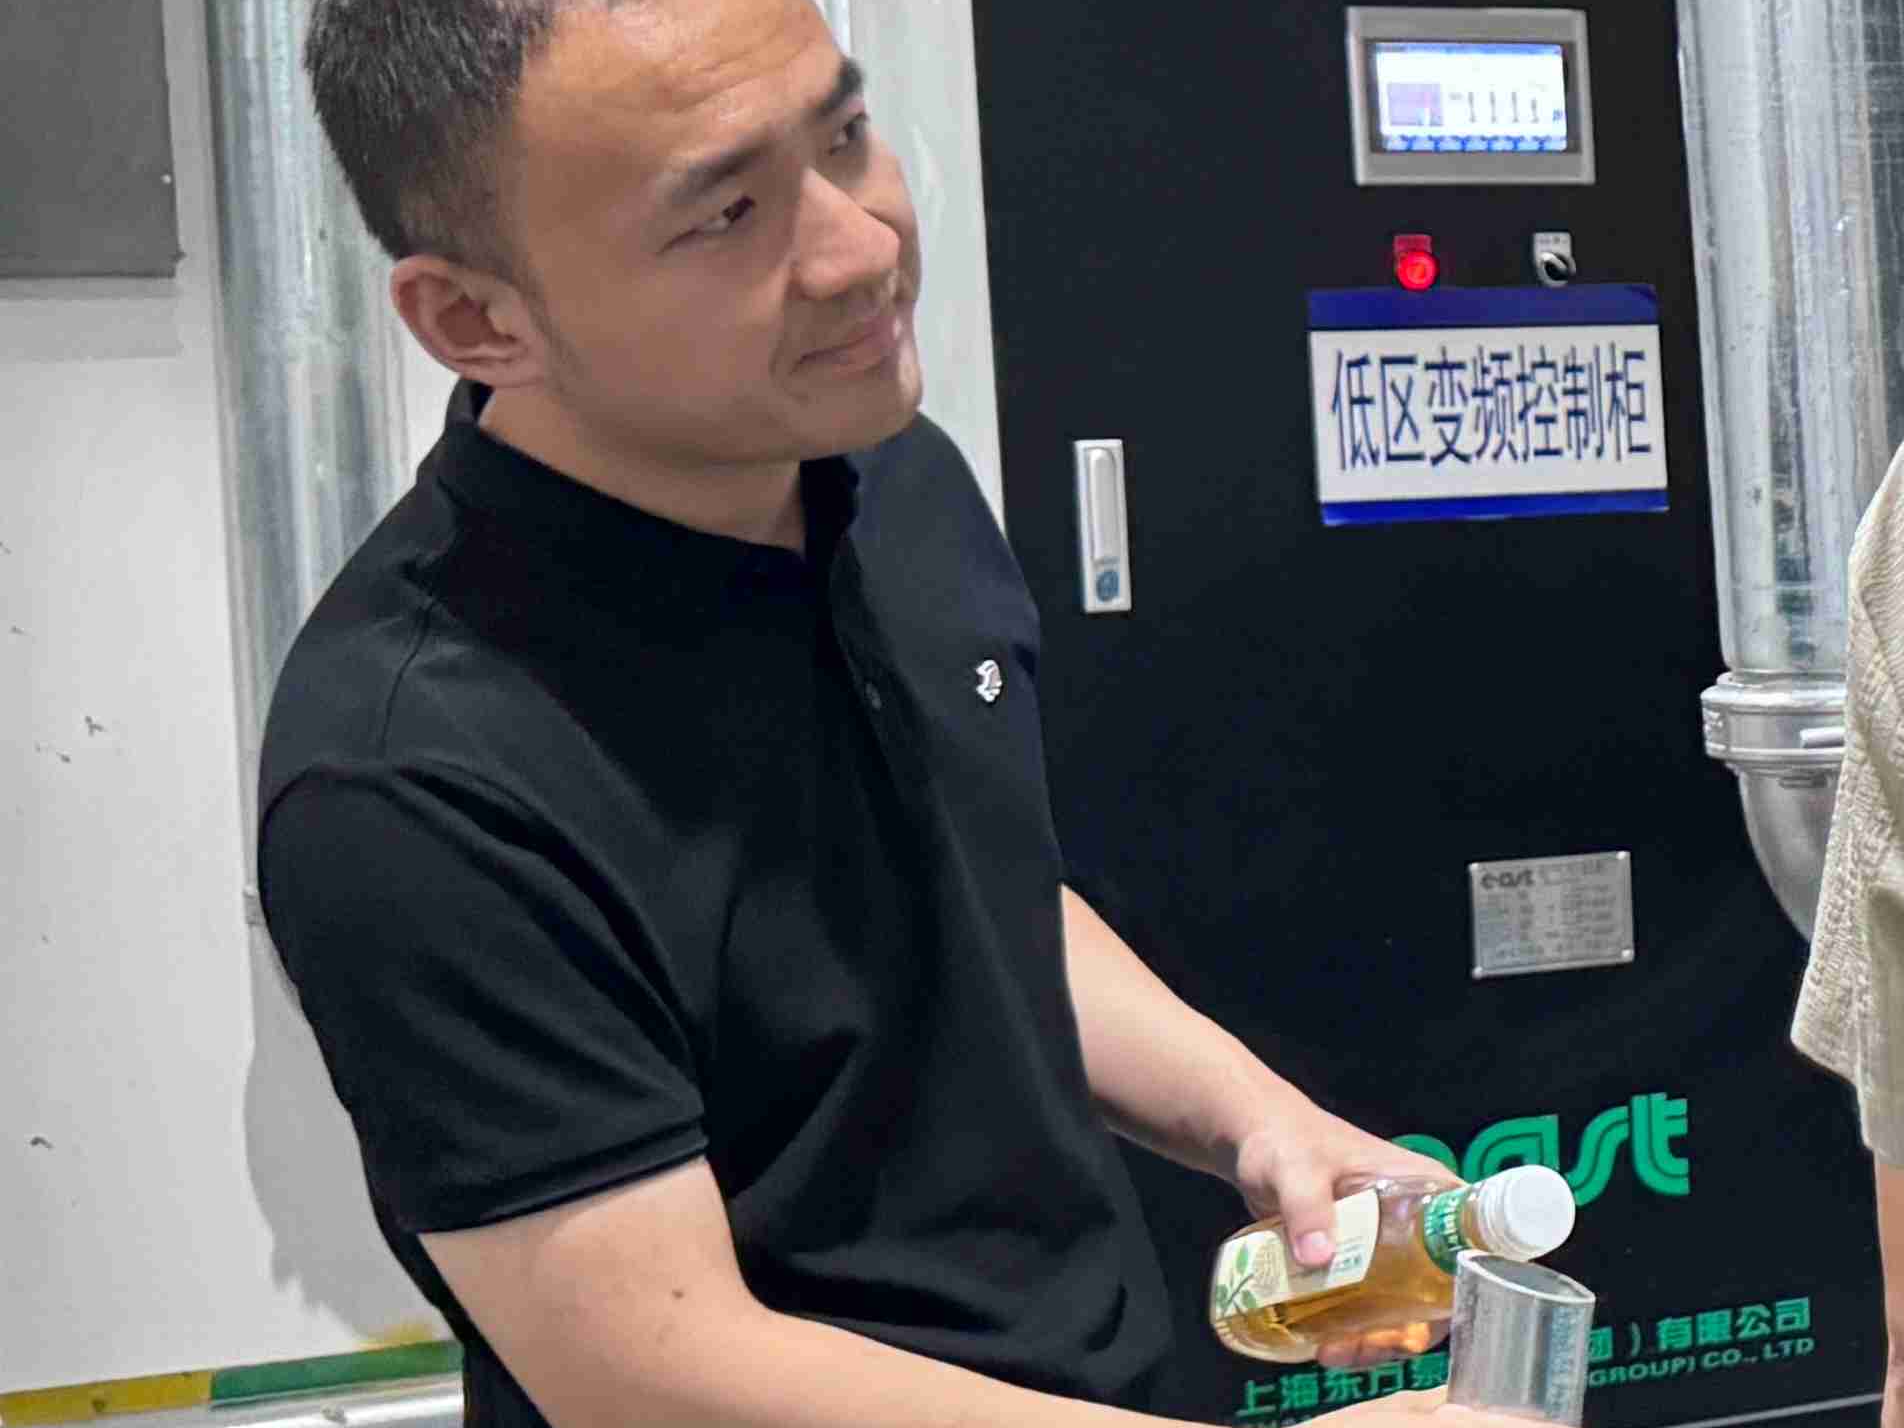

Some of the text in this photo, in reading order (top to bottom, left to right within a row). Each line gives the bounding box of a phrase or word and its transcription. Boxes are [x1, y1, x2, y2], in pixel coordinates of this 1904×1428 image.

[1331, 342, 1651, 471] 低区变频控制柜
[1584, 1355, 1695, 1388] GROUP)
[1763, 1338, 1814, 1361] LTD
